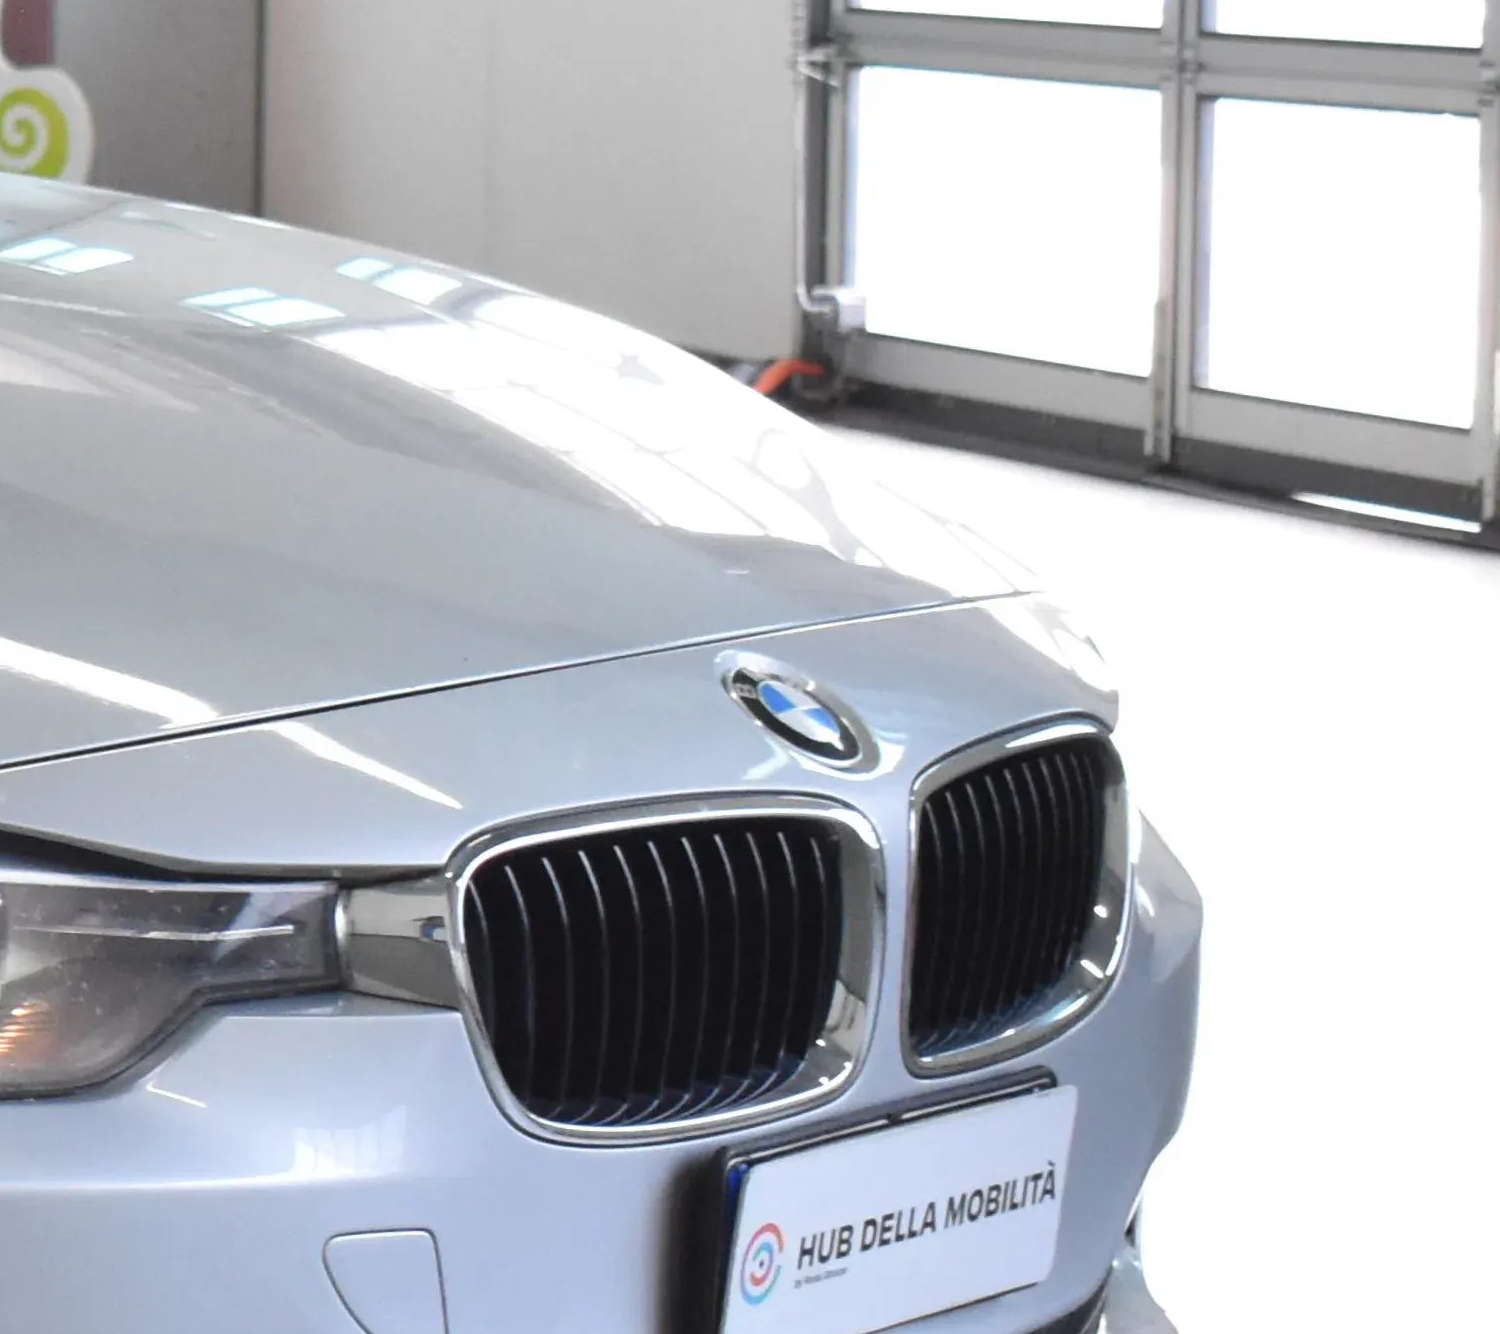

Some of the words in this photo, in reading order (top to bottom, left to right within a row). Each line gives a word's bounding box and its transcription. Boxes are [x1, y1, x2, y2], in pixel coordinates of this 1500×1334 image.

[796, 1223, 855, 1272] HUB
[858, 1200, 938, 1253] DELLA
[942, 1159, 1057, 1230] MOBILITÀ
